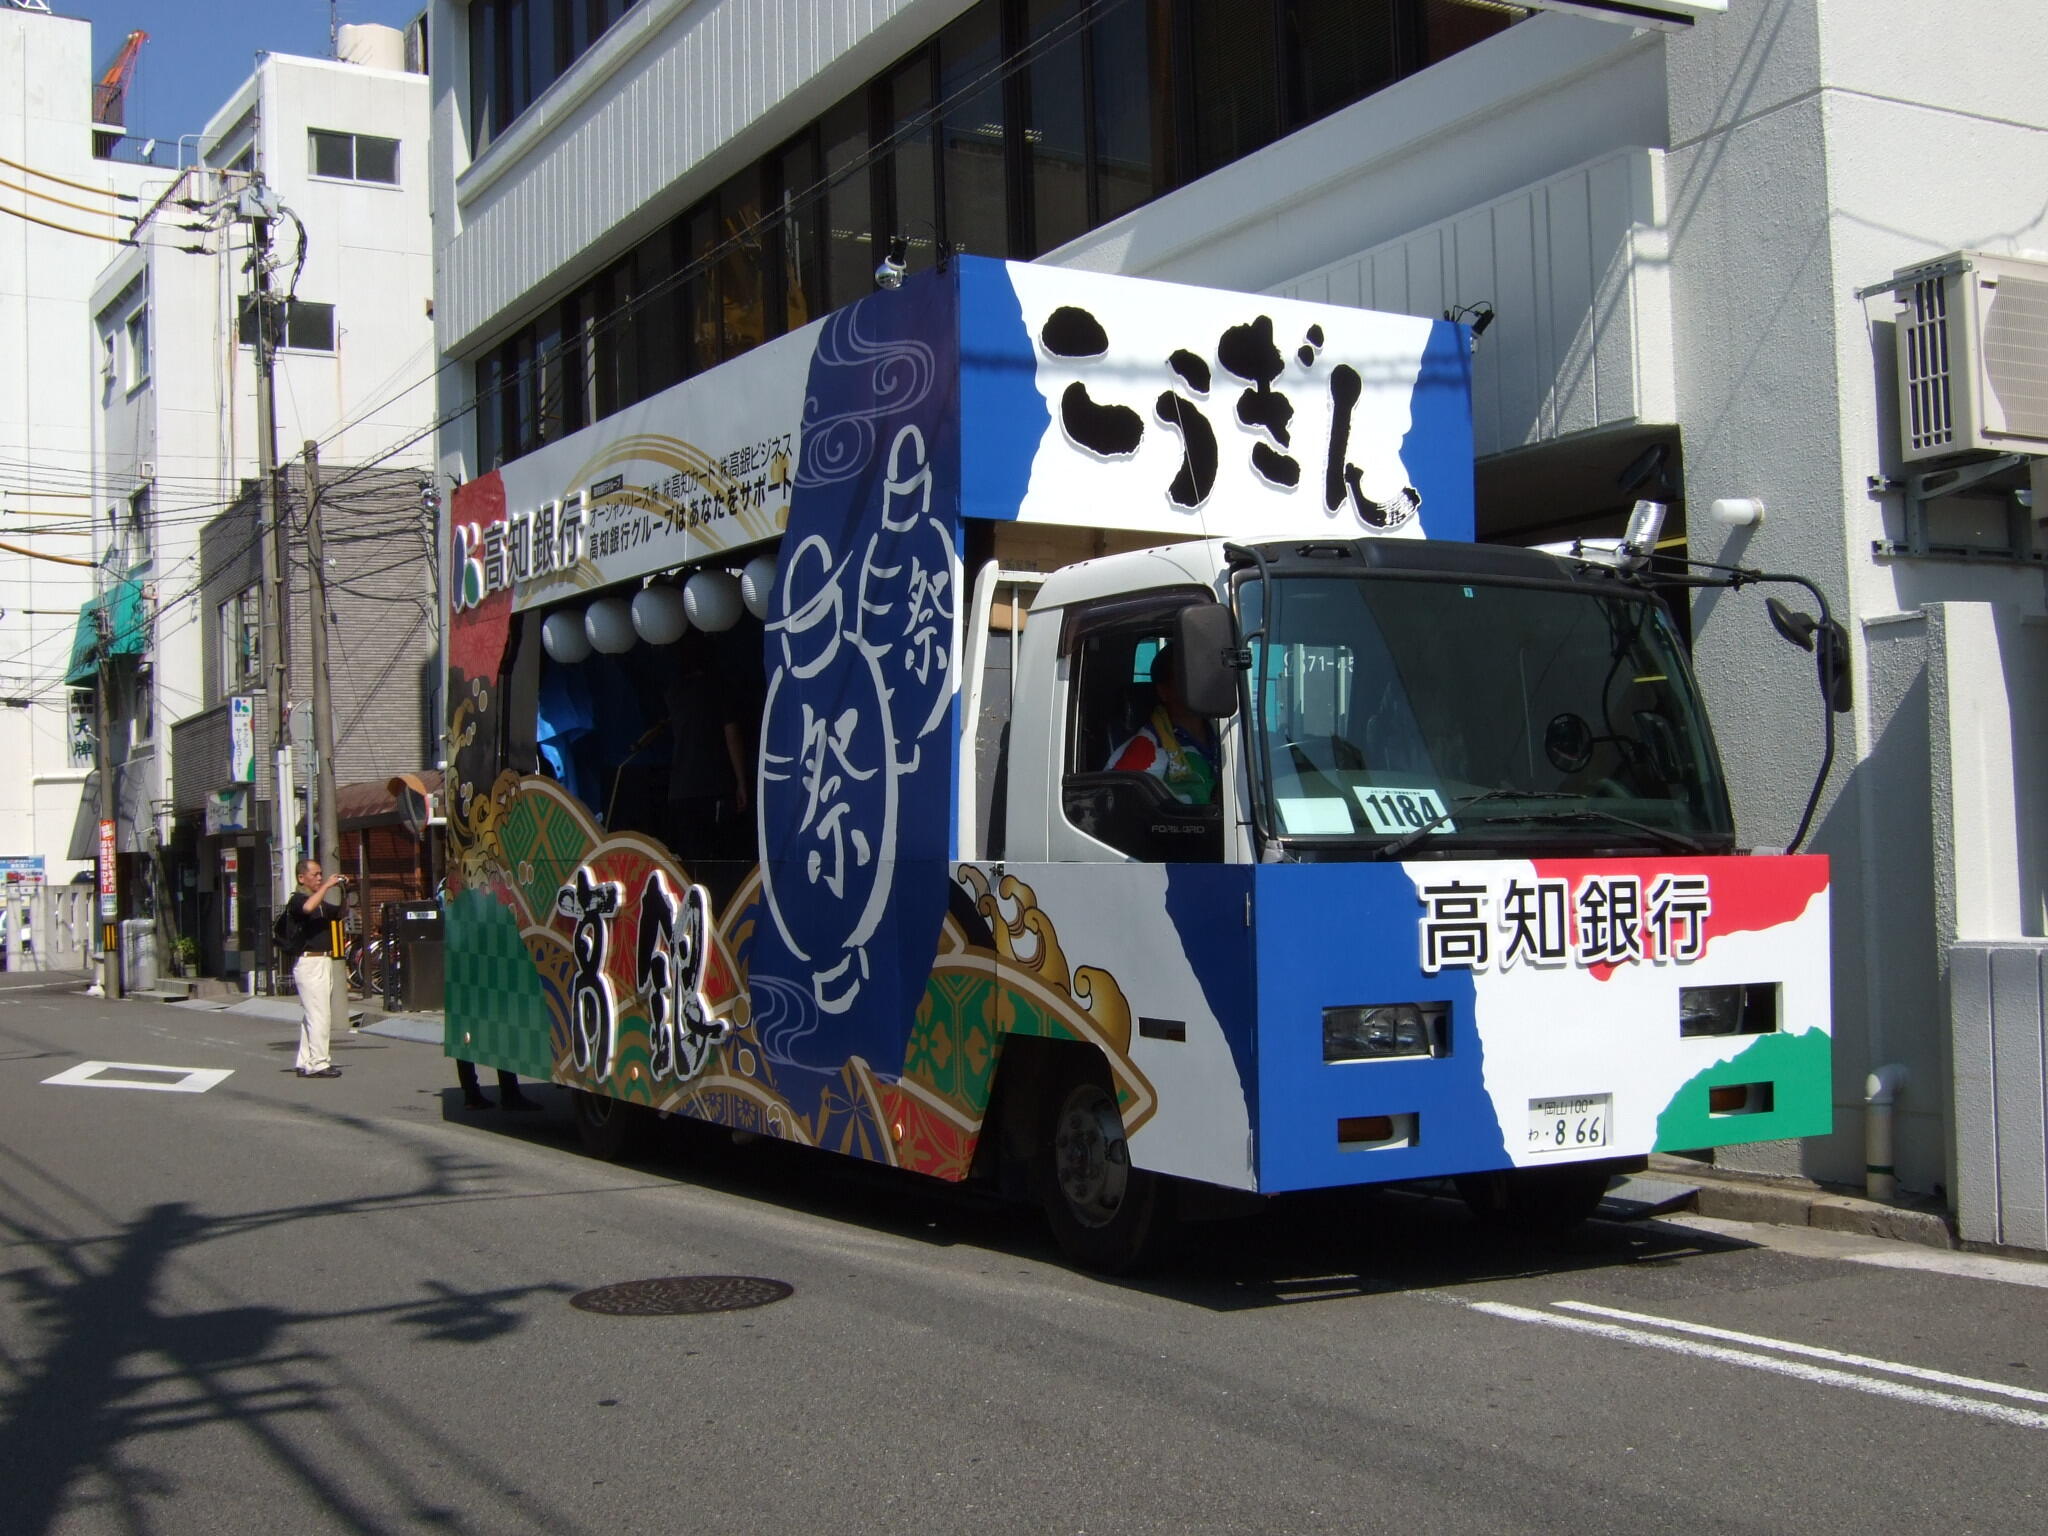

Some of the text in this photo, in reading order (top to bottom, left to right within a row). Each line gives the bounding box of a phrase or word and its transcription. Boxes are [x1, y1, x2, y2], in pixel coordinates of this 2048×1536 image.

[1041, 305, 1421, 527] こうぎん
[484, 493, 585, 591] 高知銀行
[902, 555, 954, 688] 祭
[799, 702, 878, 900] 祭
[1366, 794, 1445, 829] 1184
[1422, 877, 1709, 969] 高知銀行
